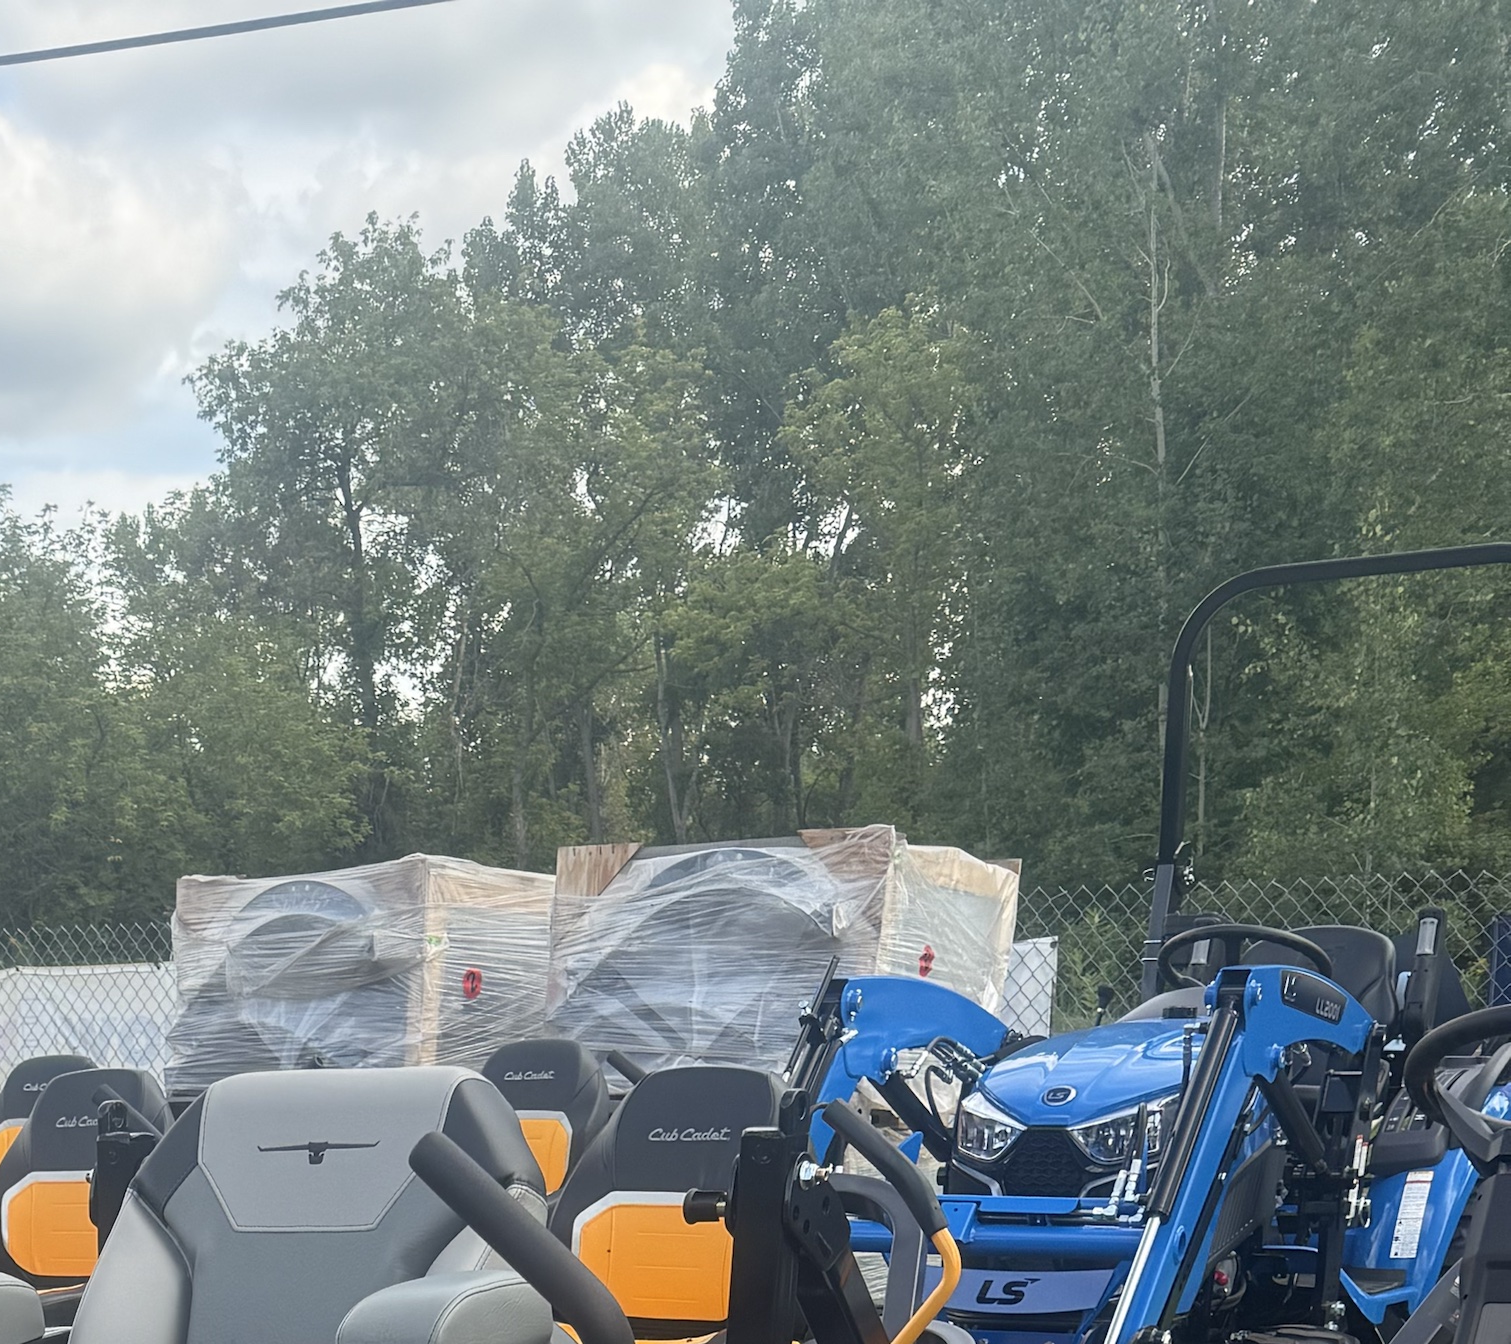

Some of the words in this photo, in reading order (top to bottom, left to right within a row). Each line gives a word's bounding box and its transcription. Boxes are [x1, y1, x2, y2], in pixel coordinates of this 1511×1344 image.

[56, 1116, 77, 1128] Cub
[648, 1128, 678, 1141] Cub
[679, 1127, 730, 1141] Cadet
[976, 1278, 1039, 1305] LS
